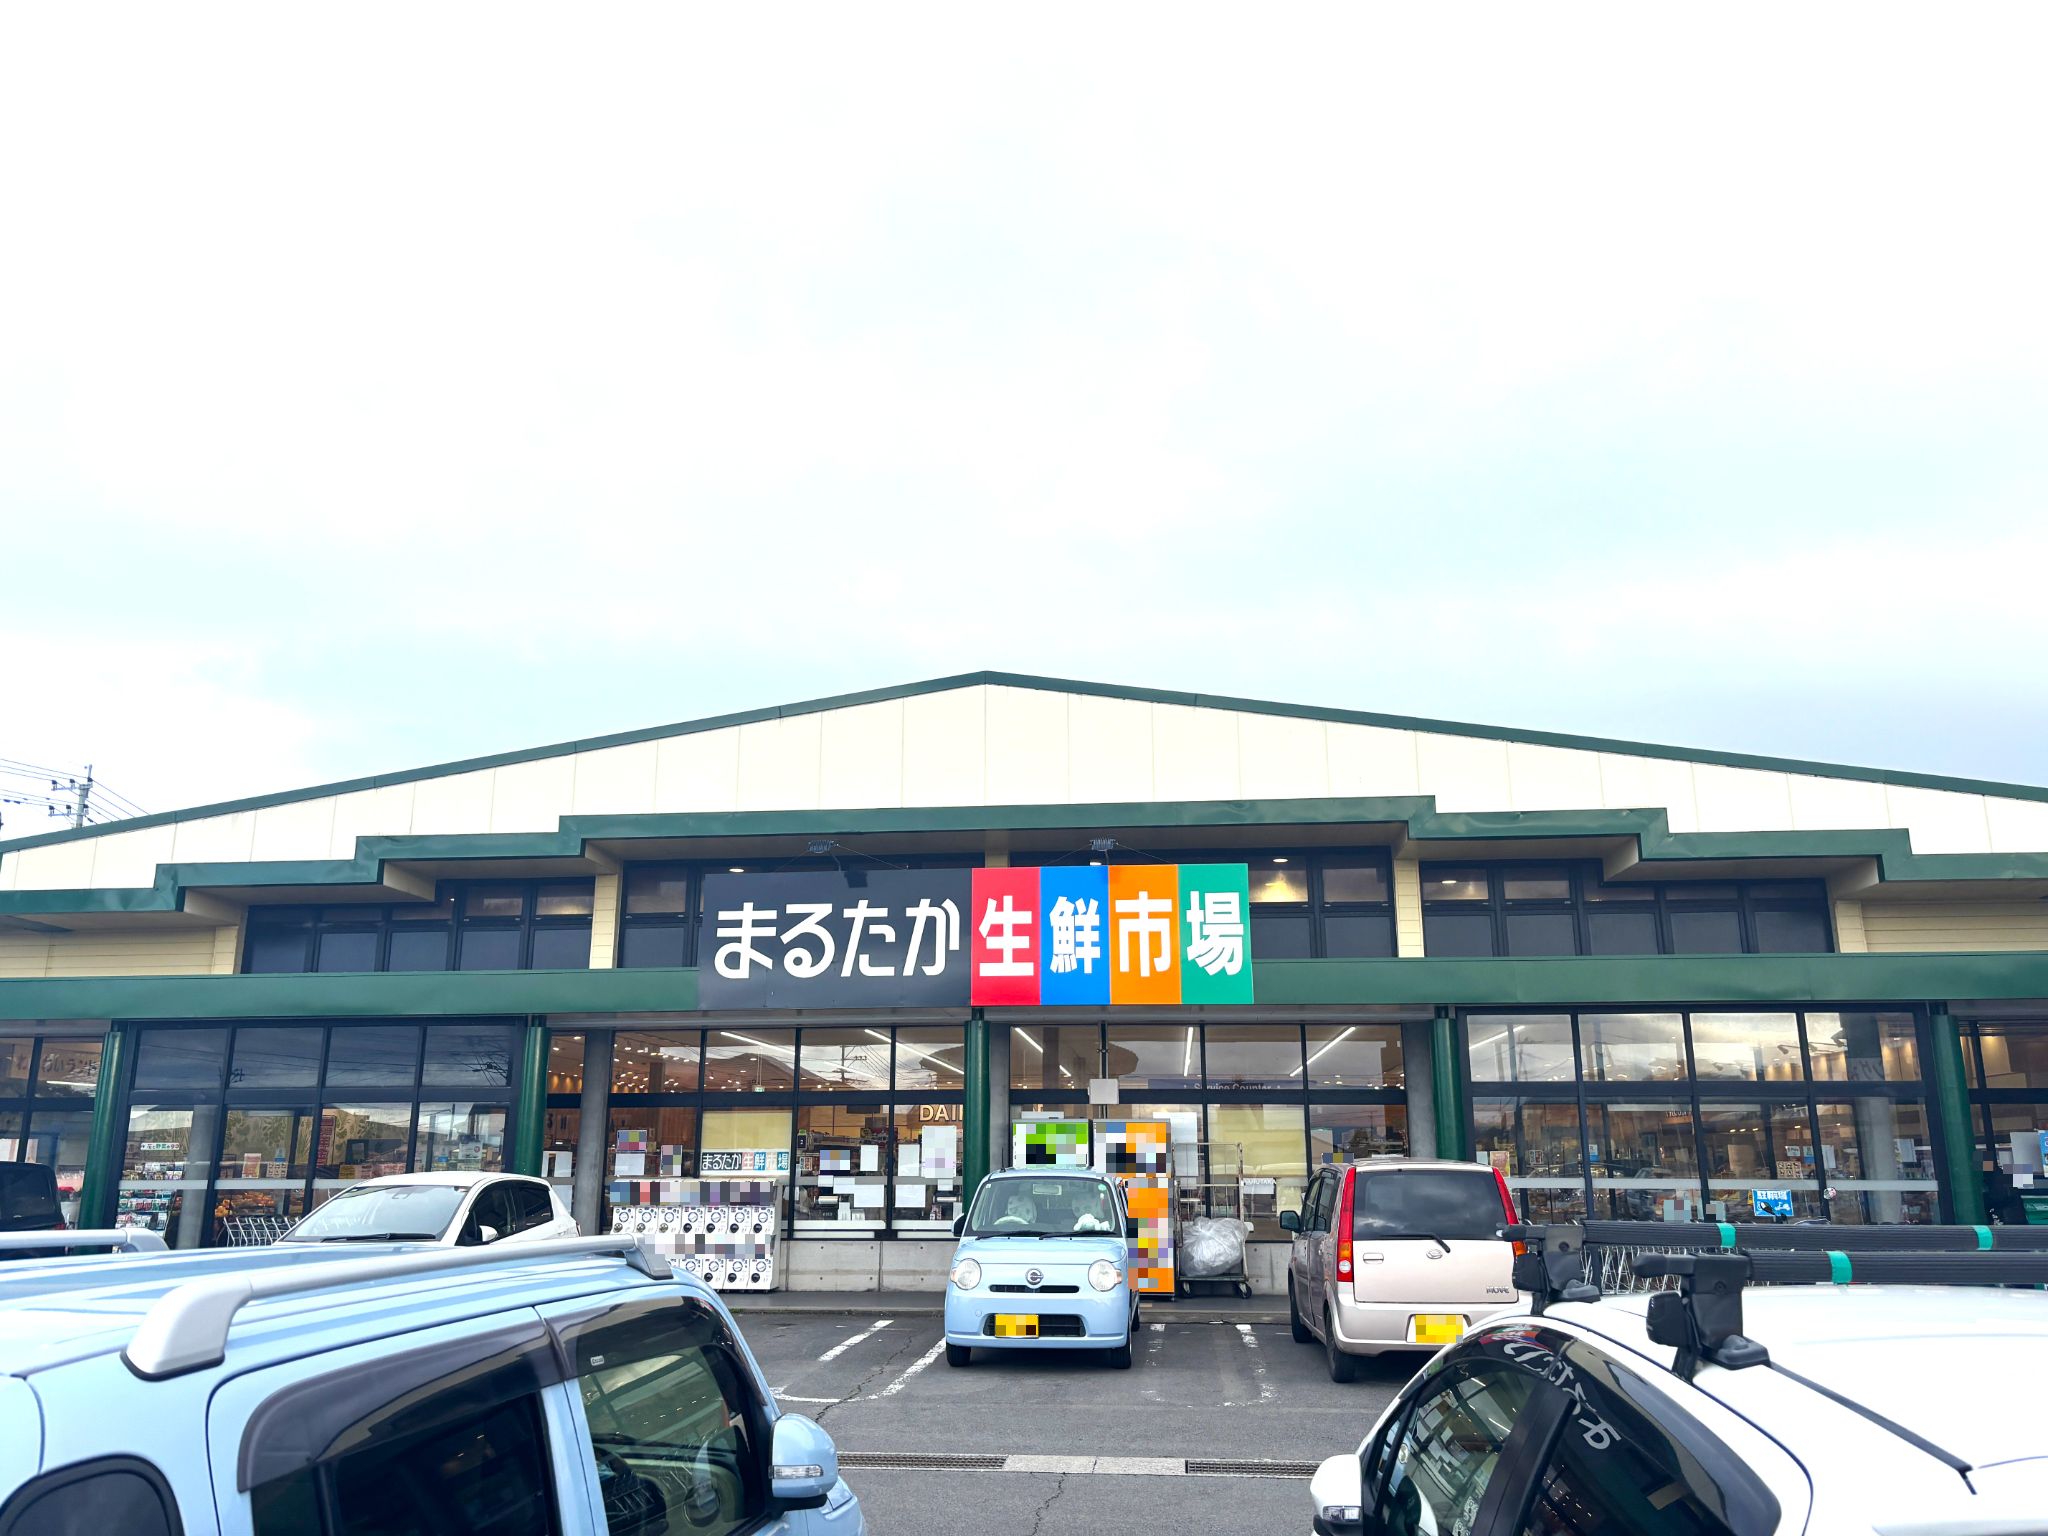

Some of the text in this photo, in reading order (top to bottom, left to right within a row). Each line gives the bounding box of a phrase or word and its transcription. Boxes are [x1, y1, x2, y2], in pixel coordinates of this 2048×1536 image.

[714, 891, 1244, 979] まるたか生鮮市場
